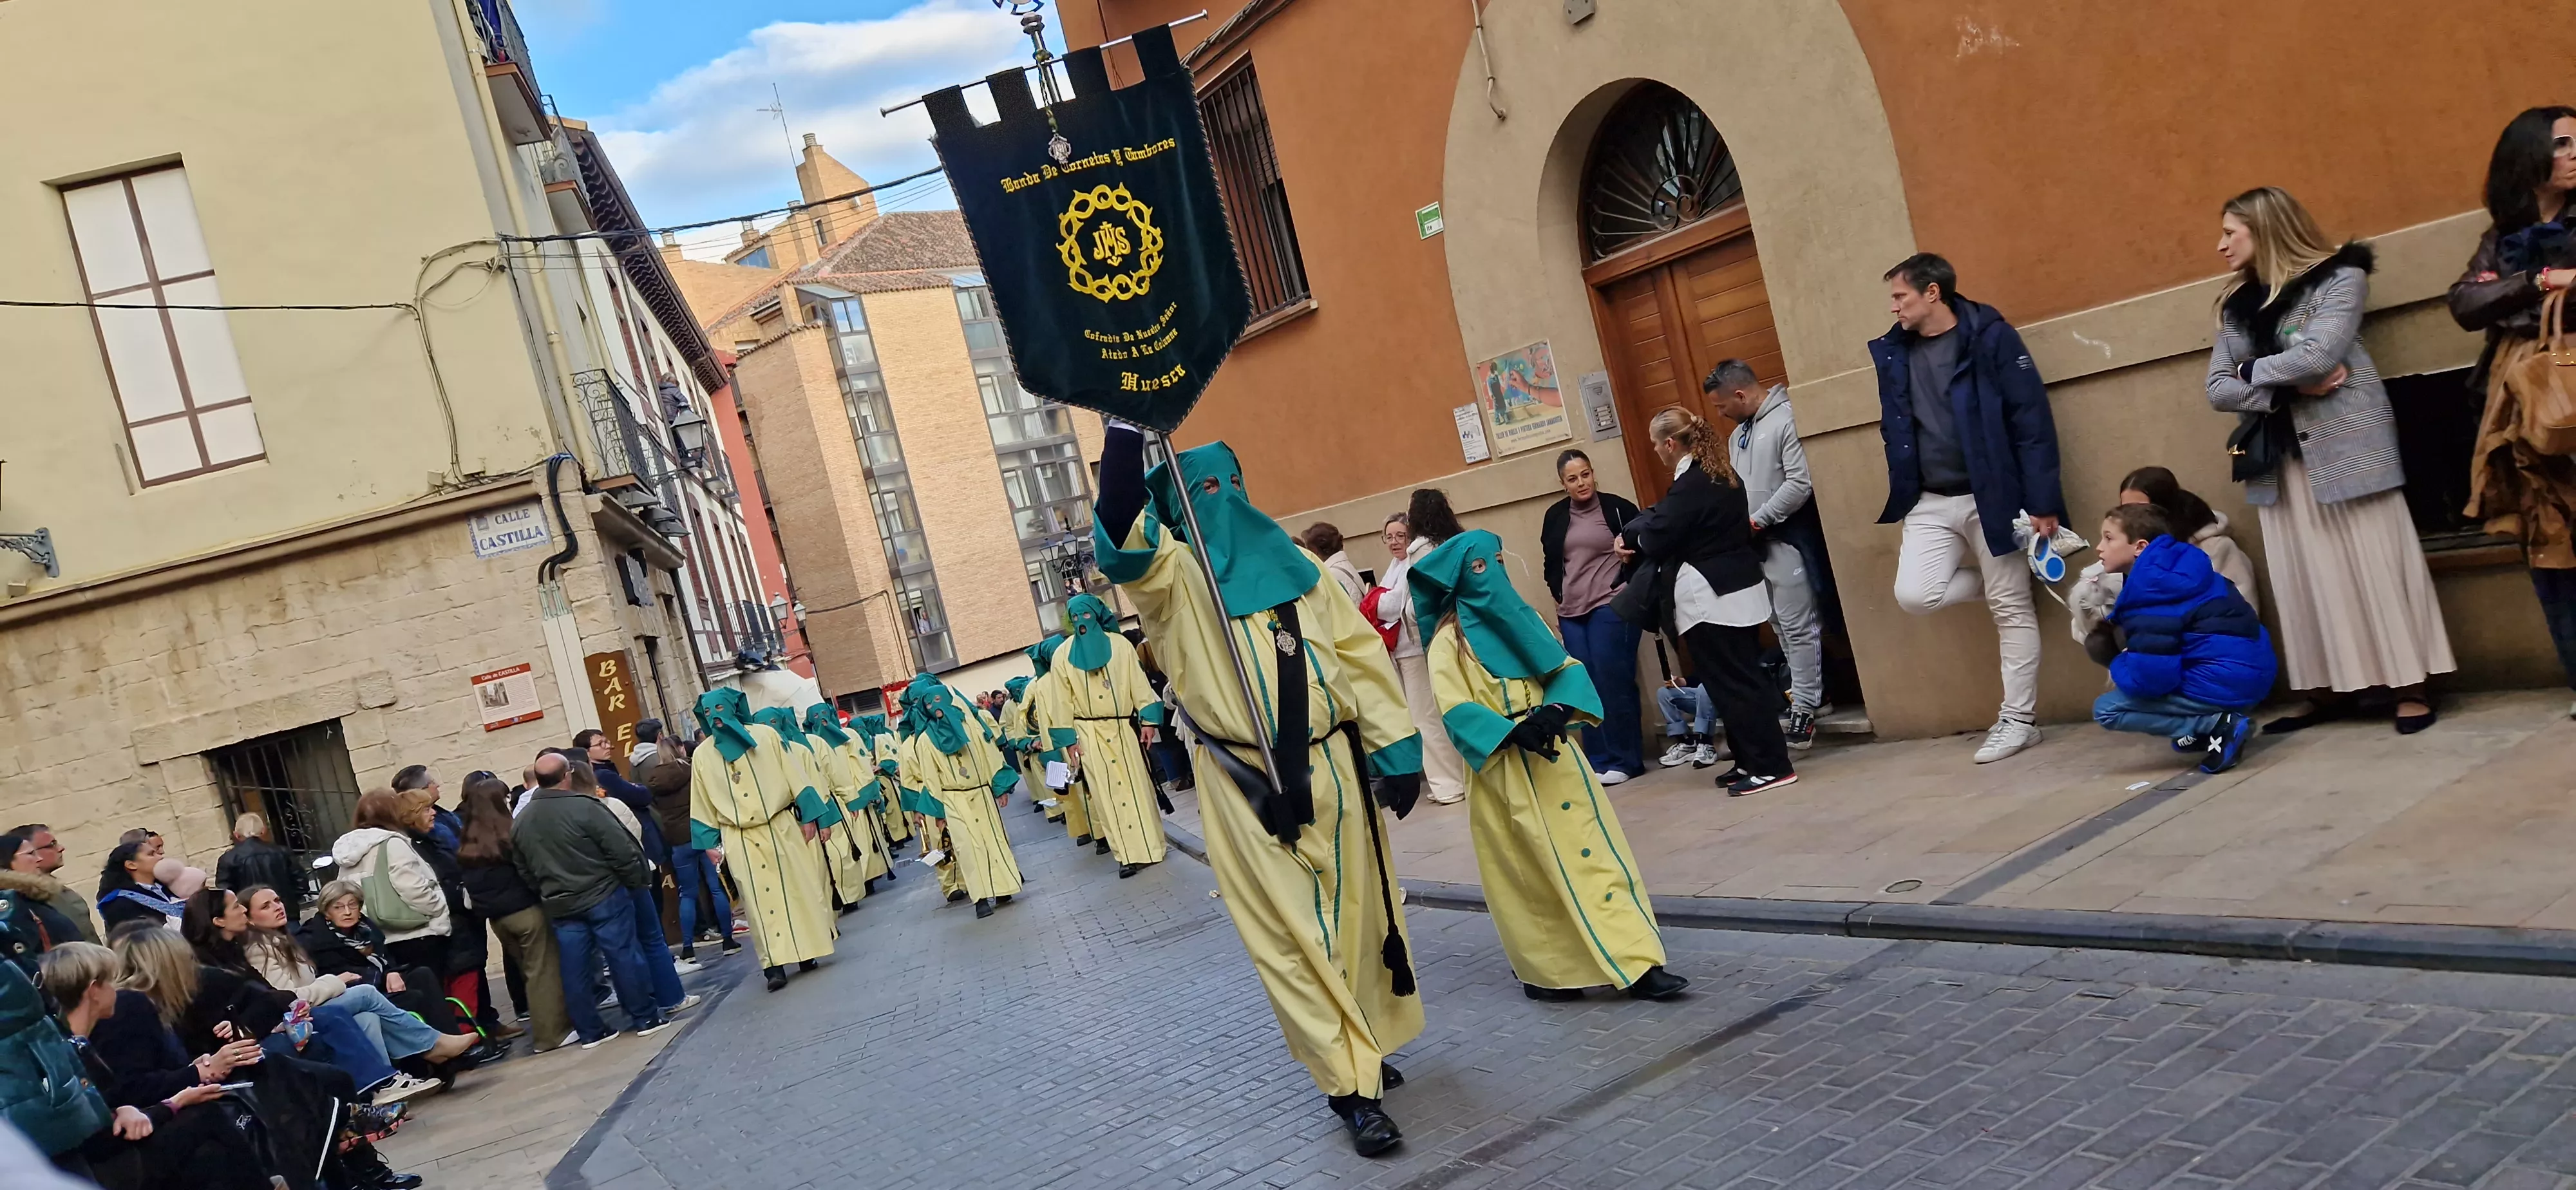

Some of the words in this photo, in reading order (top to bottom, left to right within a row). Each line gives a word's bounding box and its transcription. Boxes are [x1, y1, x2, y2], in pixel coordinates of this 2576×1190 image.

[1001, 171, 1040, 193] Banda
[1040, 164, 1058, 180] De
[1061, 151, 1111, 173] Cornetas
[1111, 149, 1123, 166] Y
[1123, 138, 1176, 161] Tambores
[1122, 332, 1135, 342] De
[1135, 323, 1160, 340] Nuestro
[1101, 348, 1128, 359] Atado
[1131, 346, 1140, 357] A
[1140, 344, 1154, 355] La
[1121, 363, 1186, 392] Huesca
[495, 509, 531, 525] CALLE
[479, 525, 544, 551] CASTILLA
[498, 667, 520, 677] CASTILLA
[599, 659, 626, 712] BAR
